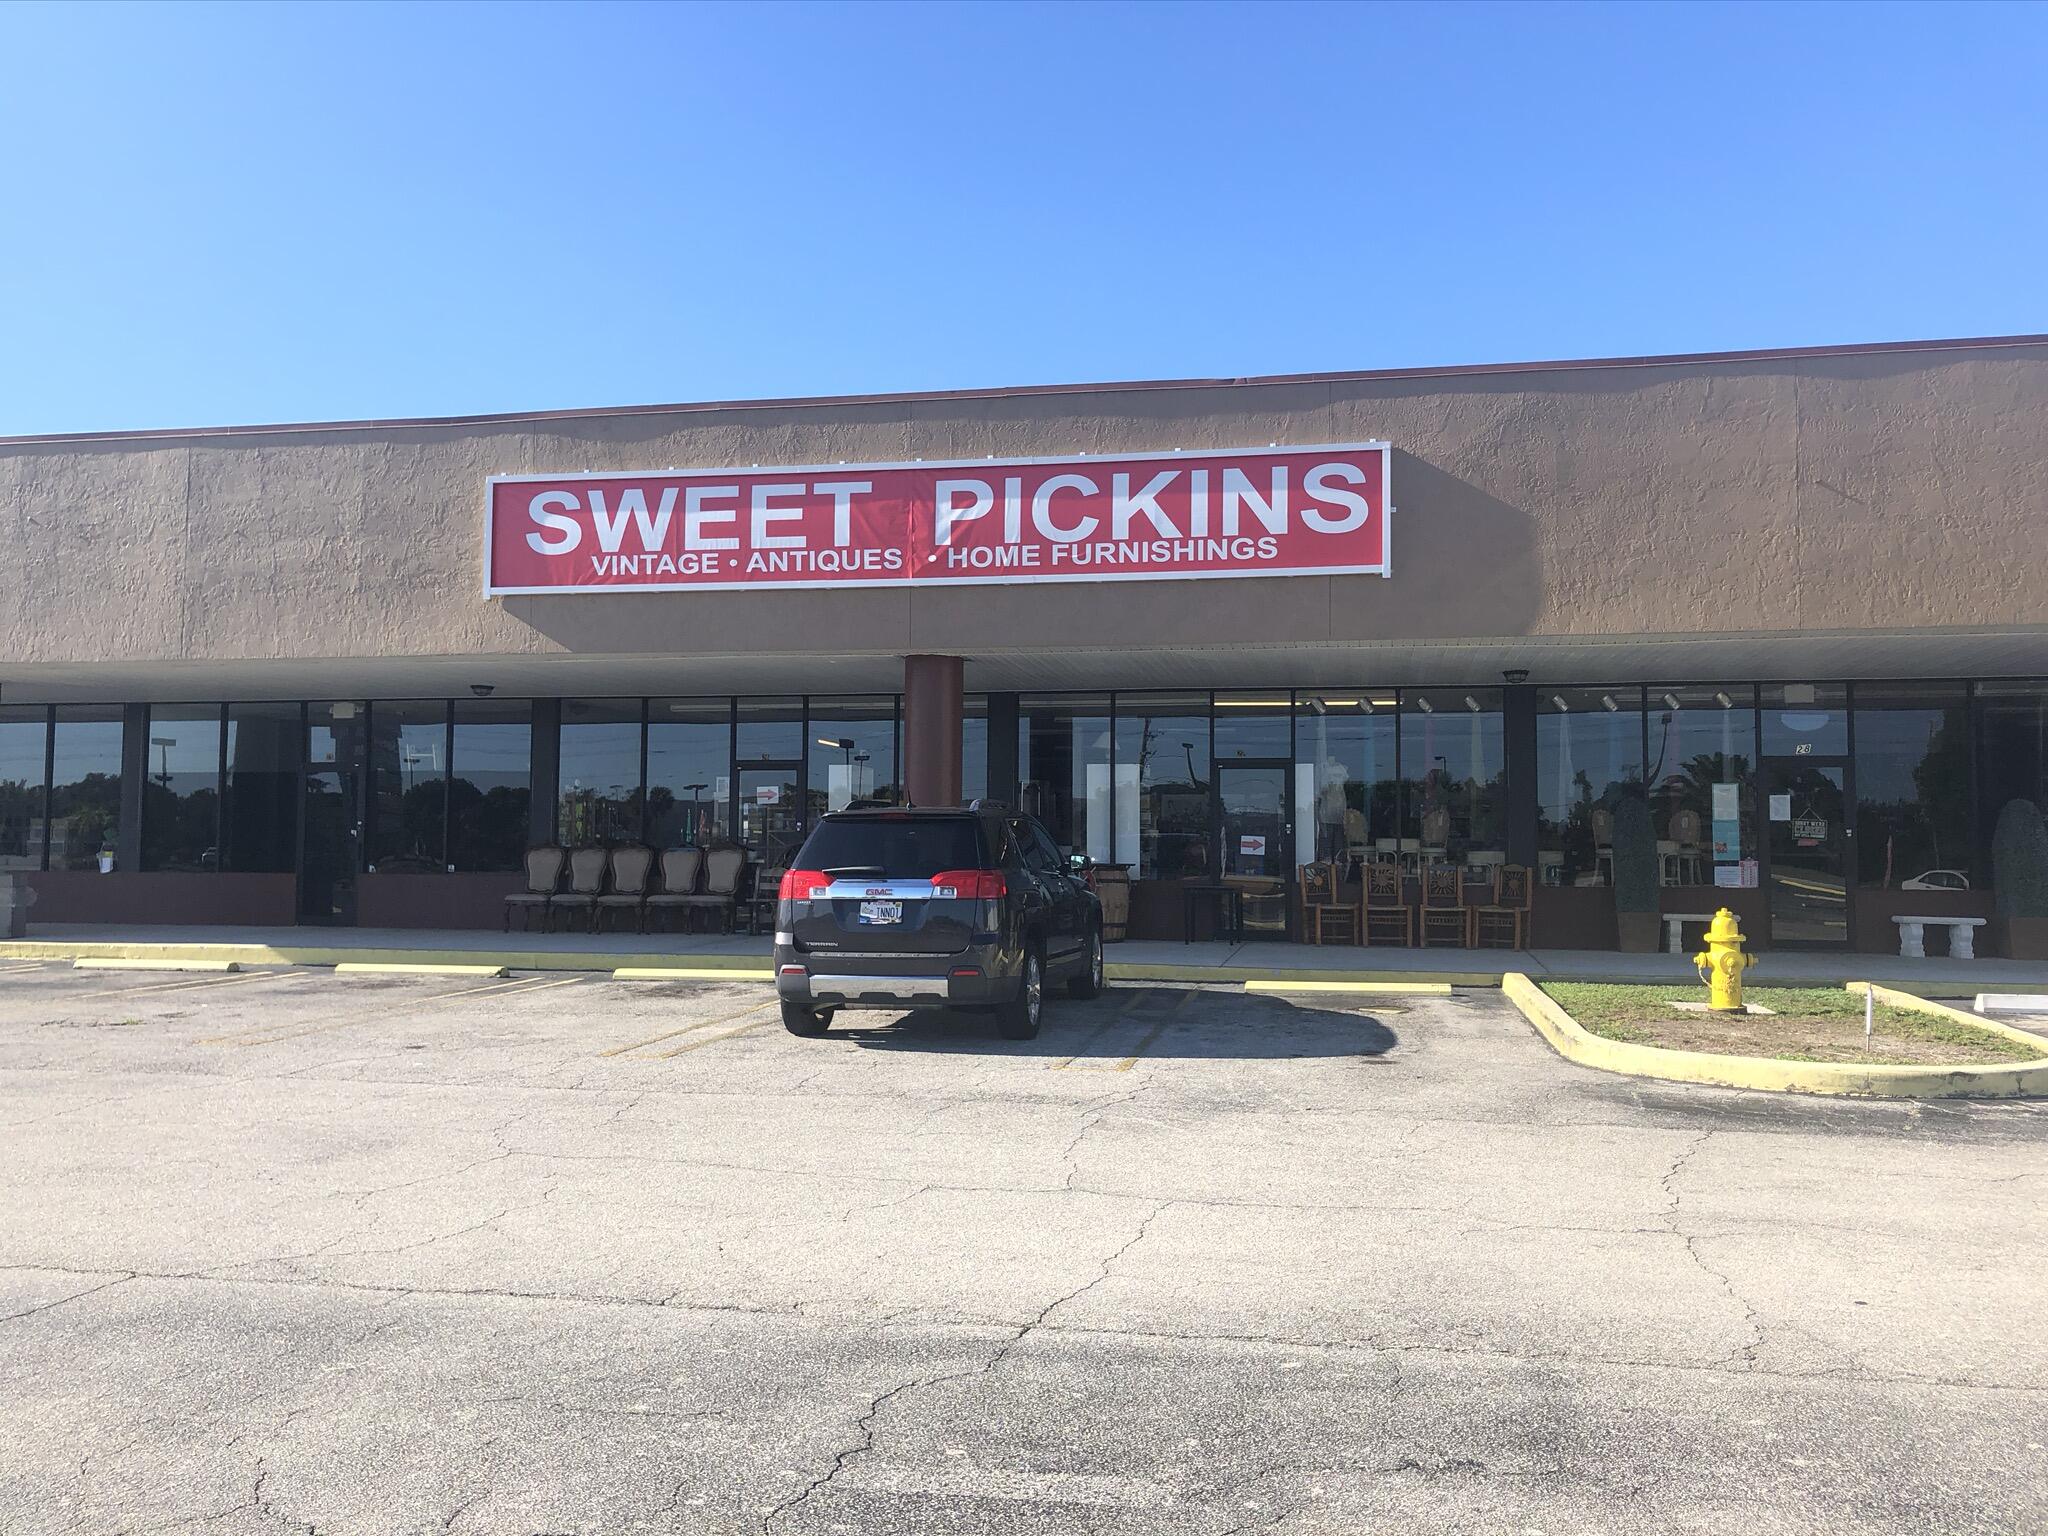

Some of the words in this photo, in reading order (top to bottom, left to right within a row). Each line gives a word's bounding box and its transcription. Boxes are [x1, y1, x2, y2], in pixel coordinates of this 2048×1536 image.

[525, 481, 873, 556] SWEET
[934, 462, 1370, 547] PICKINS
[591, 553, 720, 577] VINTAGE
[746, 547, 904, 574] ANTIQUES
[948, 544, 1041, 569] HOME
[1053, 536, 1279, 566] FURNISHINGS
[865, 888, 893, 896] GMC
